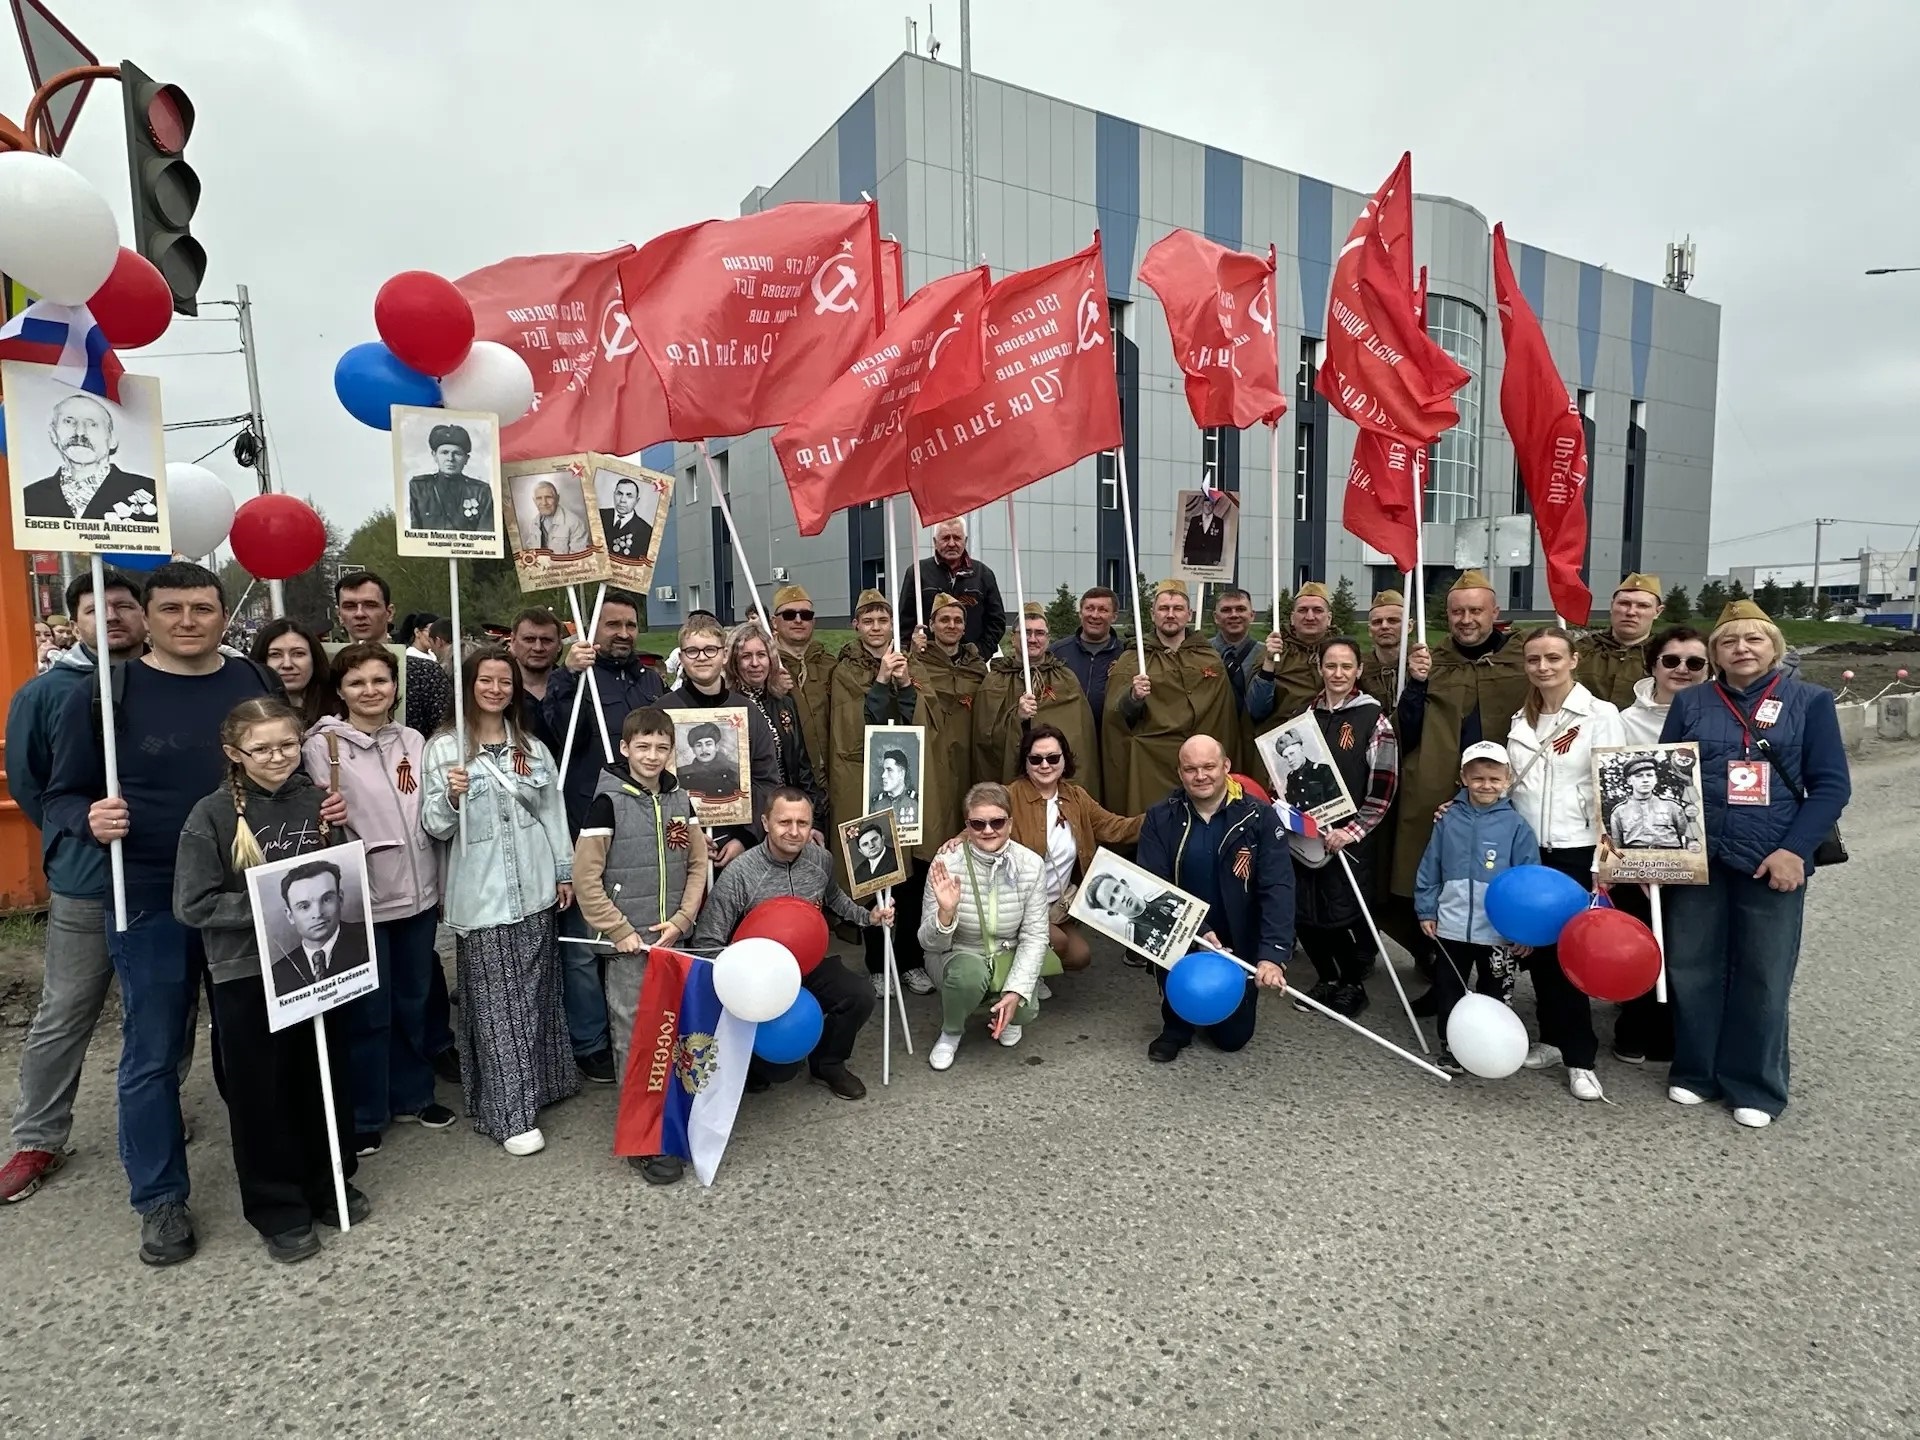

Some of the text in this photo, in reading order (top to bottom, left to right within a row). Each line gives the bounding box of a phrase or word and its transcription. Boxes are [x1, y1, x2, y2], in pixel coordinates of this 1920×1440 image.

[25, 518, 160, 534] ЕВСЕЕВ СТЕПАН АЛЕКСЕЕВИЧ
[1611, 868, 1637, 878] Иван
[646, 1010, 677, 1093] РОССИЯ
